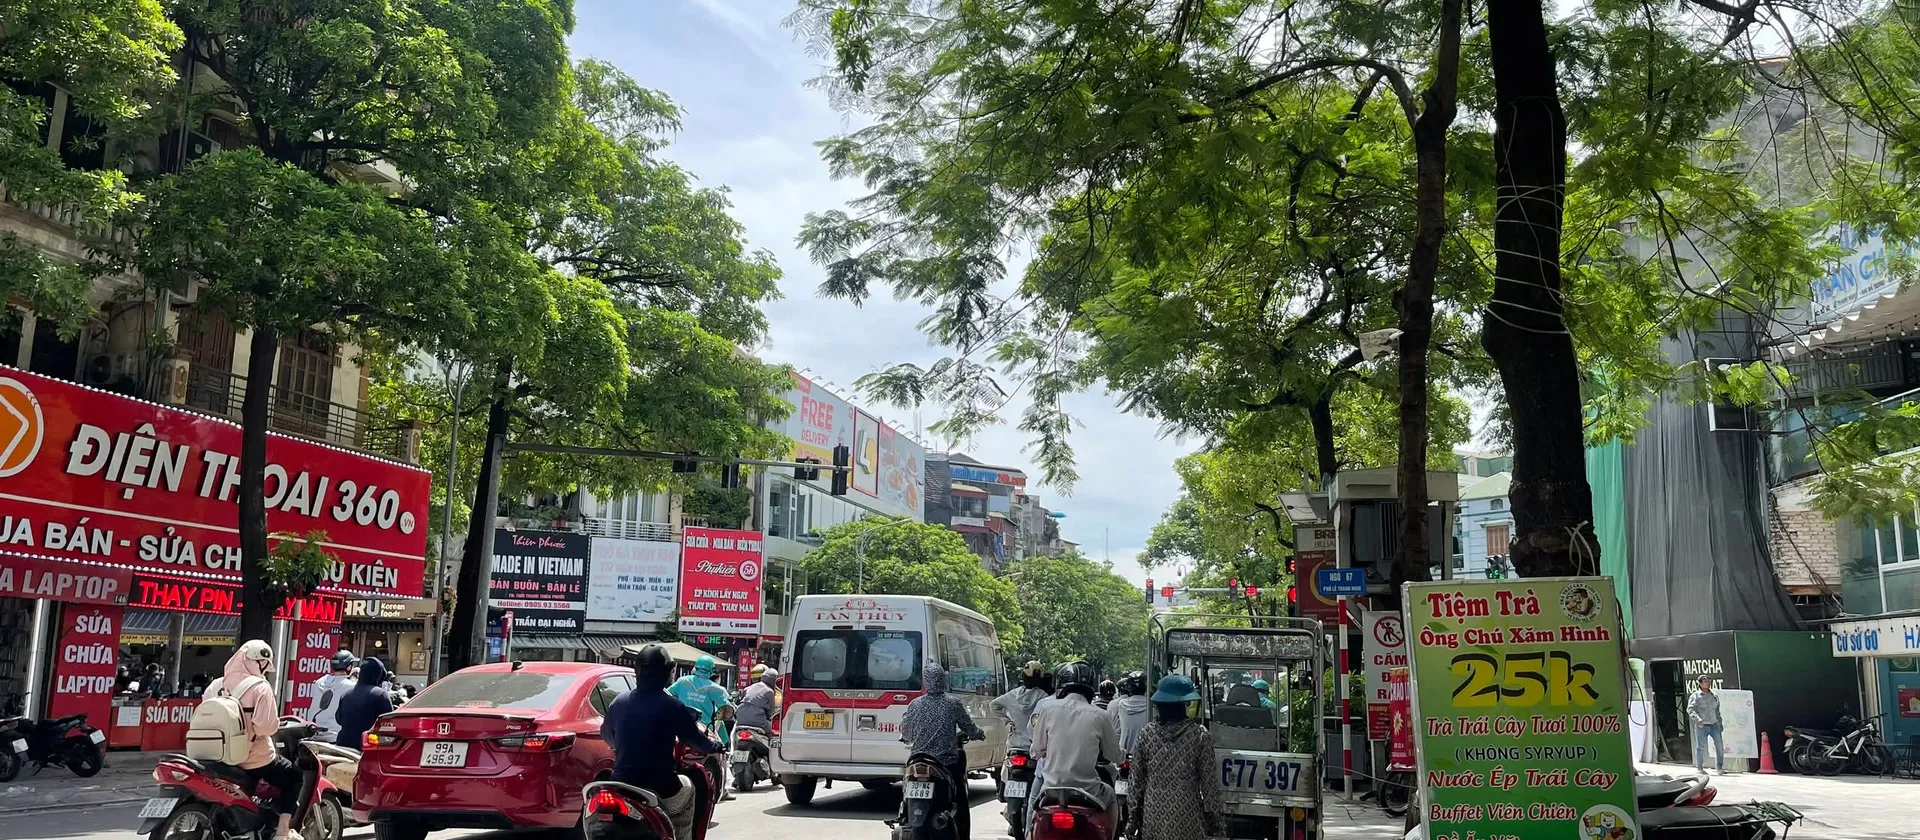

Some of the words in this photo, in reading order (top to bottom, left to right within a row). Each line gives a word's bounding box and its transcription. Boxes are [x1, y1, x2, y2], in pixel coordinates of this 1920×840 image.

[801, 396, 834, 432] FREE
[801, 429, 830, 446] DELIVERY
[66, 422, 190, 500] ĐIỆN
[333, 480, 400, 530] 360
[44, 517, 114, 556] BÁN
[139, 526, 197, 566] SỬA
[350, 559, 398, 592] KIỆN
[491, 554, 522, 574] MADE
[523, 556, 535, 575] IN
[538, 556, 584, 577] VIETNAM
[21, 569, 118, 600] LAPTOP
[139, 581, 197, 607] THAY
[199, 588, 234, 611] PIN
[489, 577, 510, 590] BÁN
[513, 579, 539, 591] BUÔN
[547, 580, 566, 593] BÁN
[569, 580, 580, 593] LẺ
[380, 602, 406, 611] Korean
[380, 610, 401, 618] foods
[705, 602, 717, 611] PIN
[1427, 591, 1490, 624] Tiệm
[1495, 589, 1541, 616] Trà
[75, 610, 112, 635] SỬA
[306, 628, 331, 649] SỬA
[1419, 625, 1459, 649] Ông
[1464, 625, 1504, 644] Chú
[1509, 627, 1555, 644] Xăm
[1560, 625, 1610, 642] Hình
[1864, 629, 1879, 651] 60
[64, 642, 113, 665] CHỮA
[298, 655, 331, 674] CHỮA
[1373, 651, 1407, 666] CẤM
[1683, 658, 1723, 675] MATCHA
[57, 675, 116, 694] LAPTOP
[1450, 650, 1600, 708] 25k
[145, 701, 169, 724] SỬA
[1427, 718, 1454, 737] Trà
[1458, 715, 1489, 736] Trái
[1494, 715, 1526, 738] Cây
[1531, 715, 1567, 734] Tươi
[1571, 714, 1621, 733] 100%
[426, 754, 461, 765] 496.97
[435, 743, 454, 753] 99A
[1465, 745, 1520, 761] KHÔNG
[1524, 747, 1586, 760] SYRYUP
[1221, 758, 1258, 789] 677
[1264, 760, 1302, 791] 397
[1427, 770, 1483, 788] Nước
[1490, 766, 1518, 790] Ép
[1525, 769, 1568, 787] Trái
[1574, 770, 1619, 790] Cây
[1430, 803, 1483, 822] Buffet
[1487, 802, 1524, 821] Viên
[1527, 802, 1577, 820] Chiên
